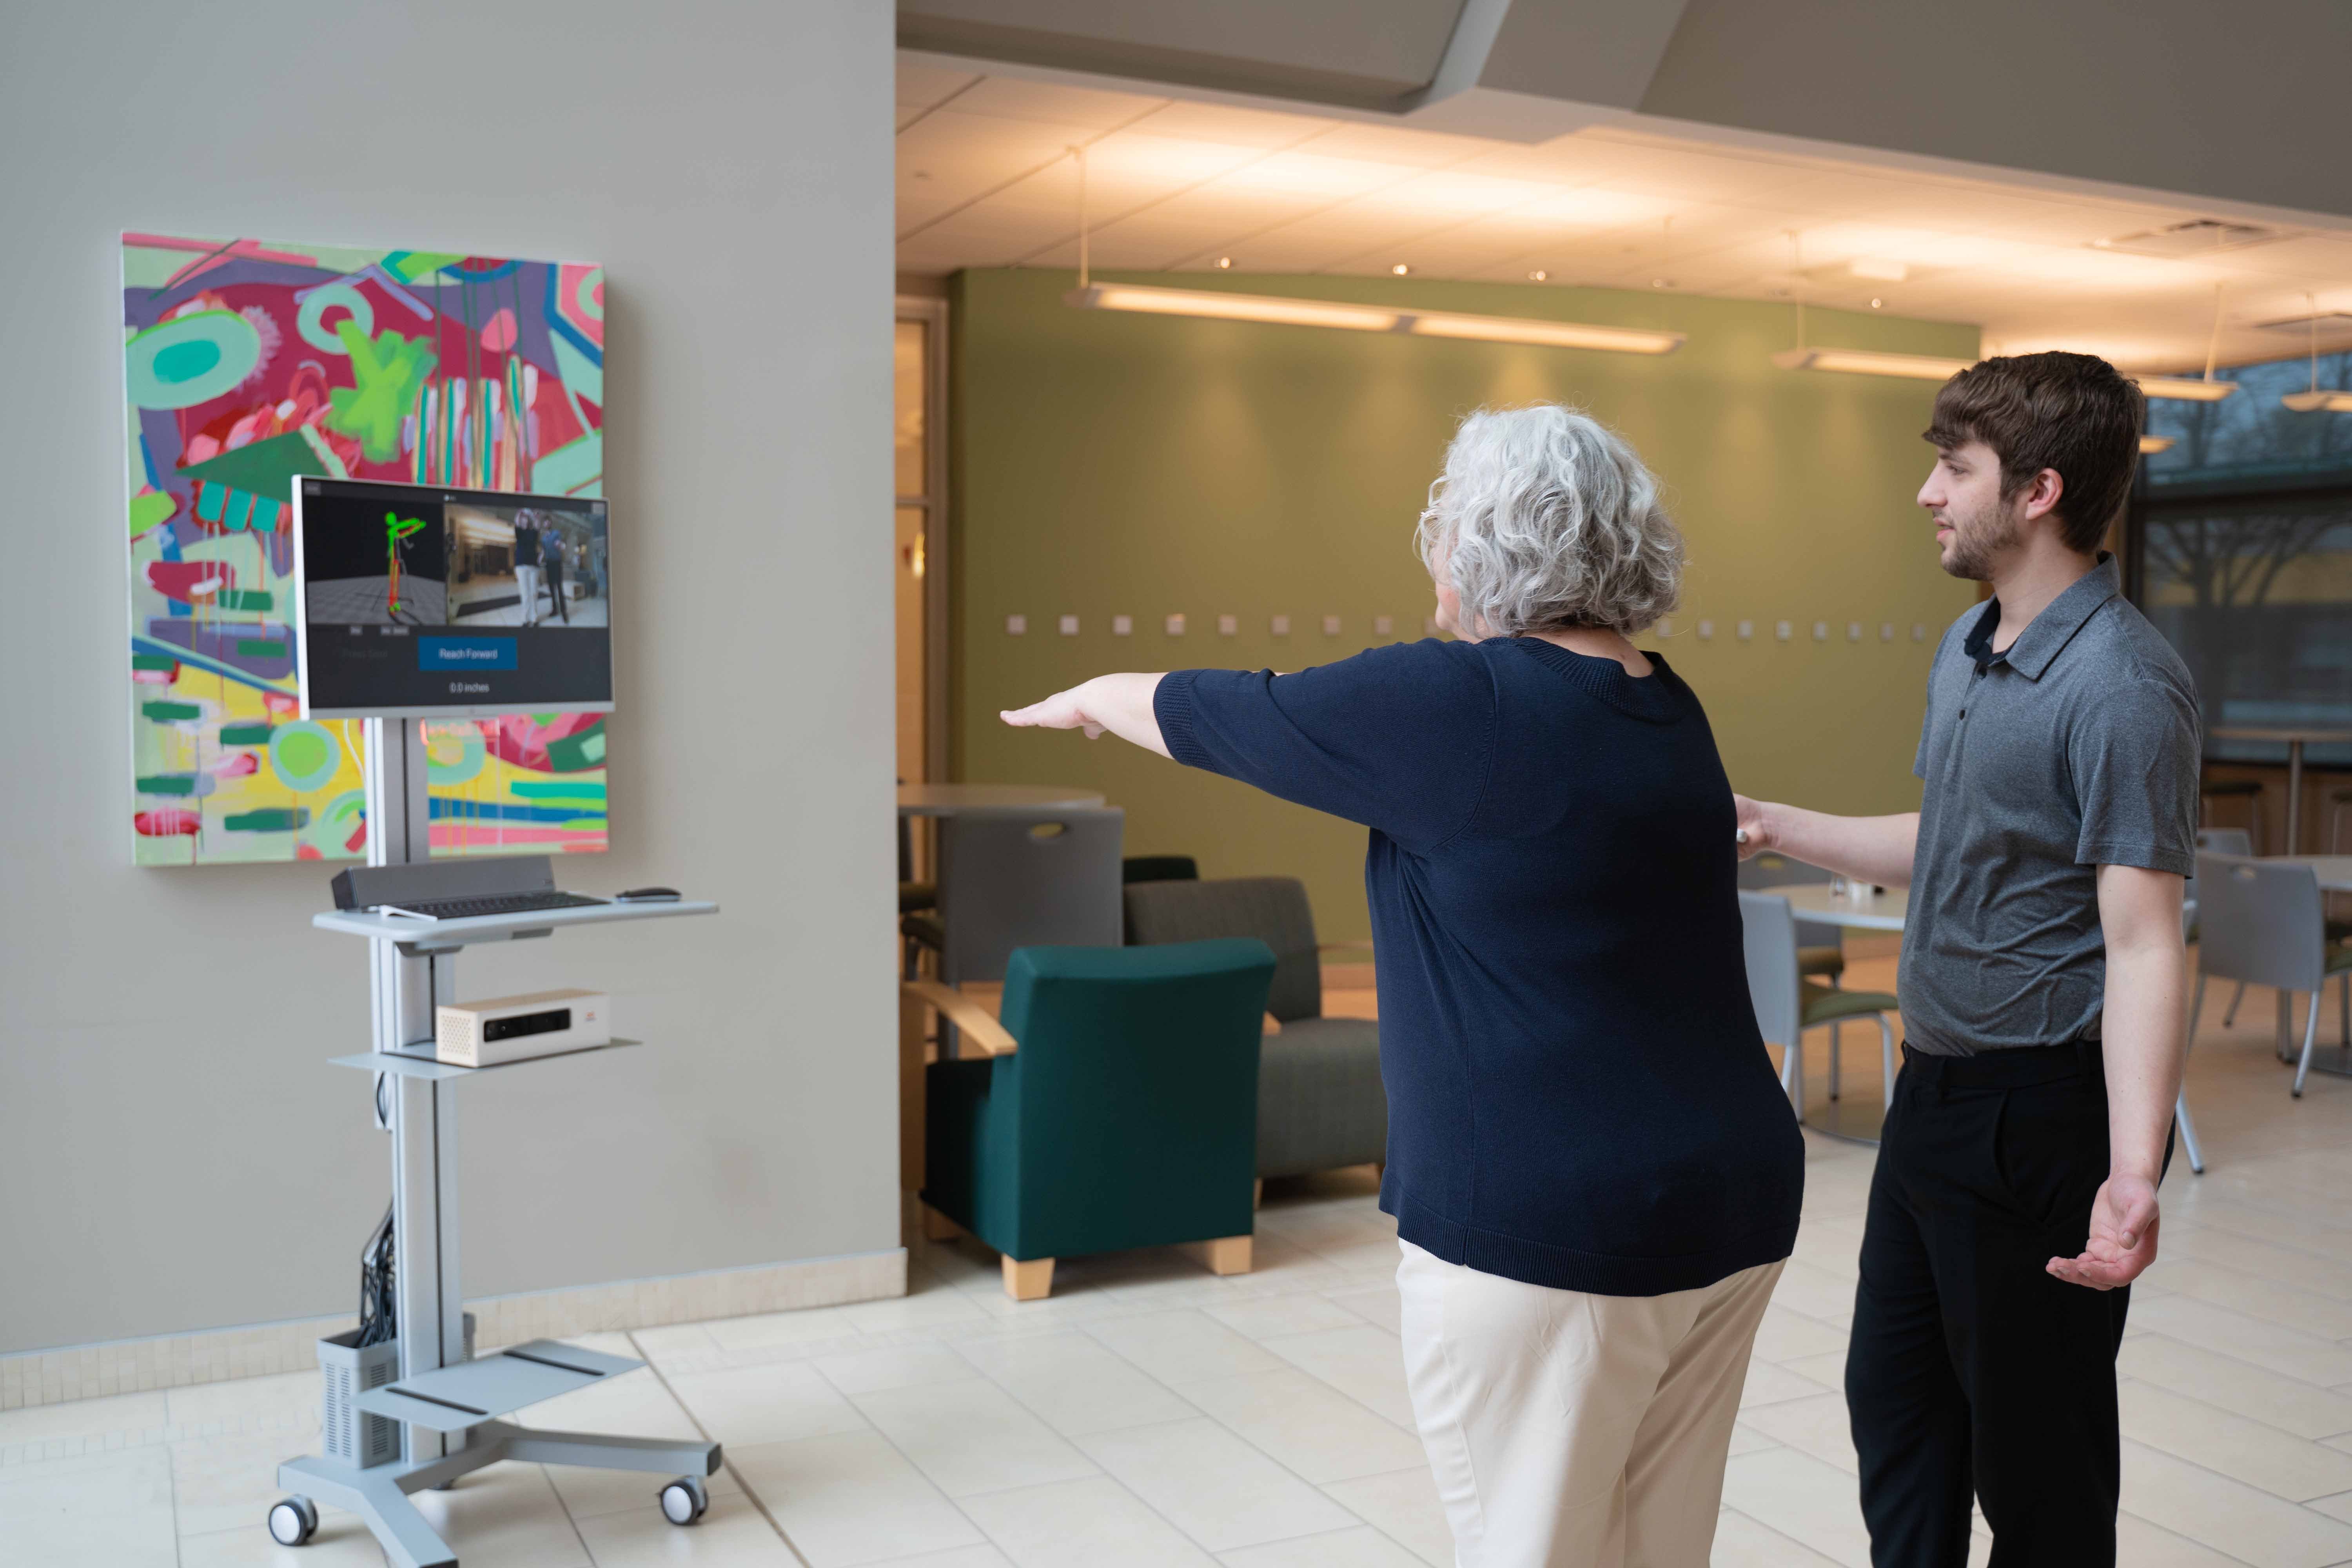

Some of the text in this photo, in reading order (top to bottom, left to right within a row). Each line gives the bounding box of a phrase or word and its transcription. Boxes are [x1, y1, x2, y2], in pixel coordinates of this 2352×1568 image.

[439, 648, 498, 659] Reach Forward
[465, 682, 489, 693] inches
